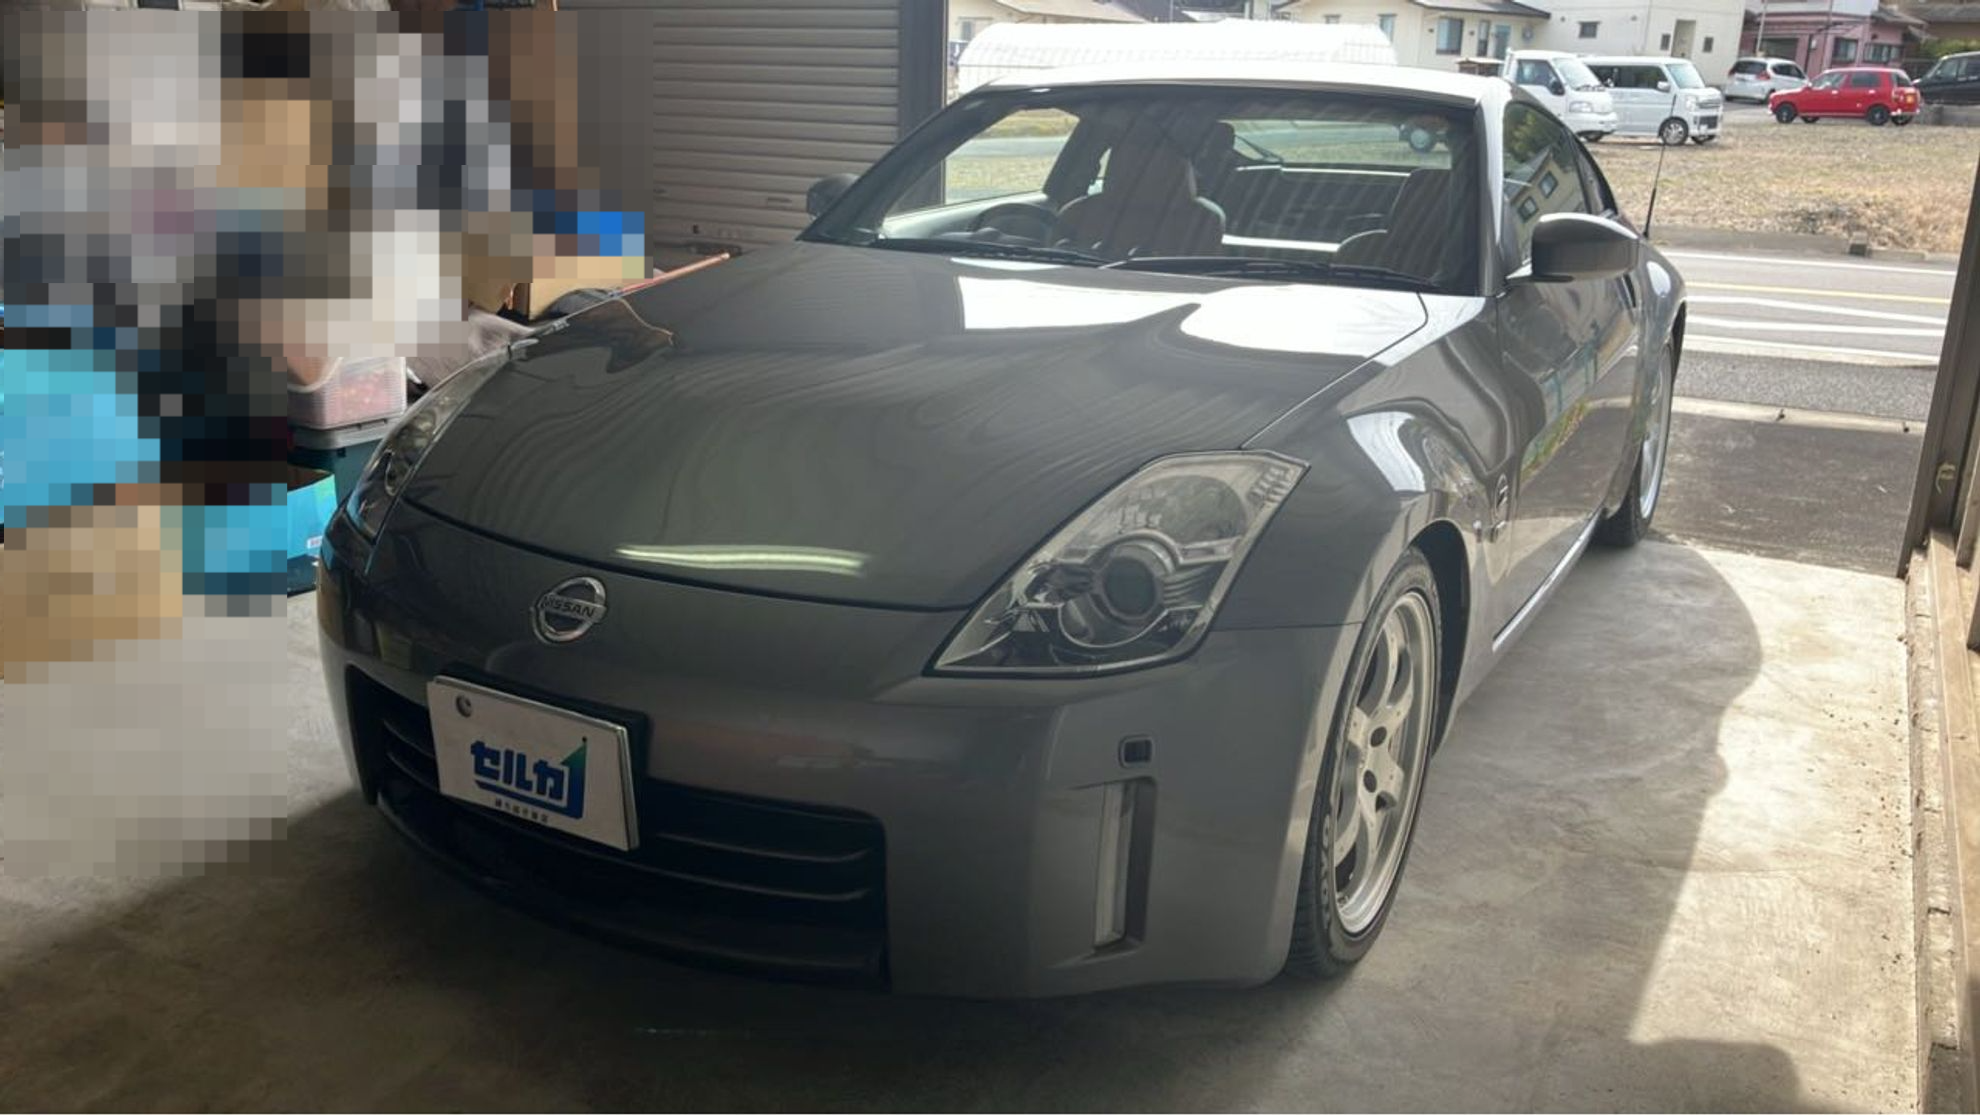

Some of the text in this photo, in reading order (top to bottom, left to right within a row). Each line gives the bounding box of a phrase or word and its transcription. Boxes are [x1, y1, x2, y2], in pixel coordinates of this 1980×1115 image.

[540, 598, 595, 618] NISSAN
[470, 740, 566, 801] セルカ
